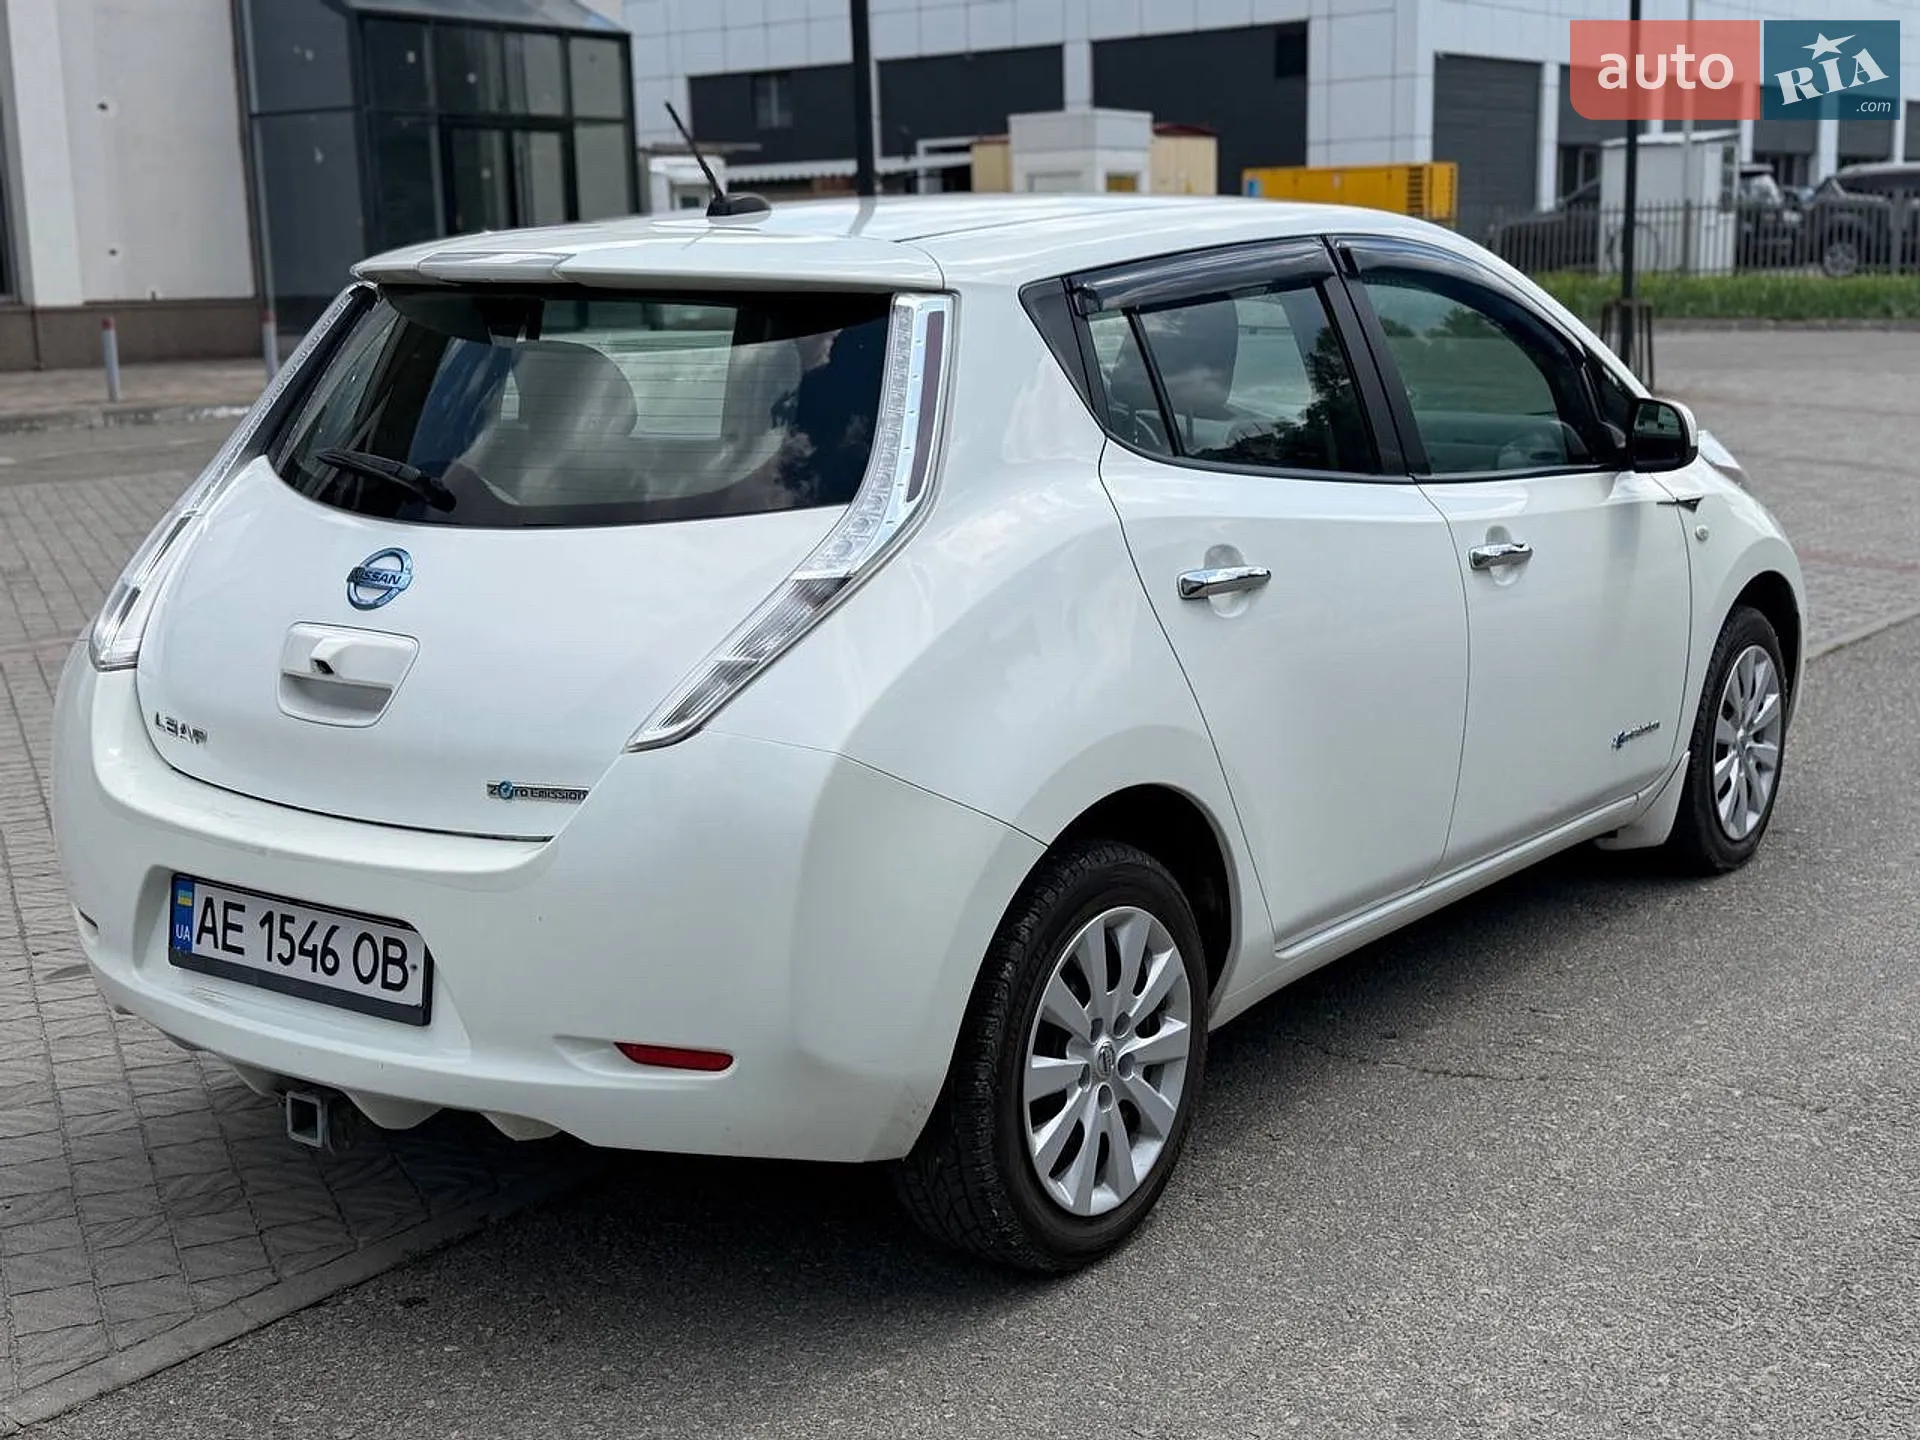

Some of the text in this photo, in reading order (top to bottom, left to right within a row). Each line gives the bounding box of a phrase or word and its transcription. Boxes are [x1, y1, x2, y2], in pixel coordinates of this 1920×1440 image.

[175, 923, 191, 942] UA
[196, 896, 409, 992] AE 1546 OB
